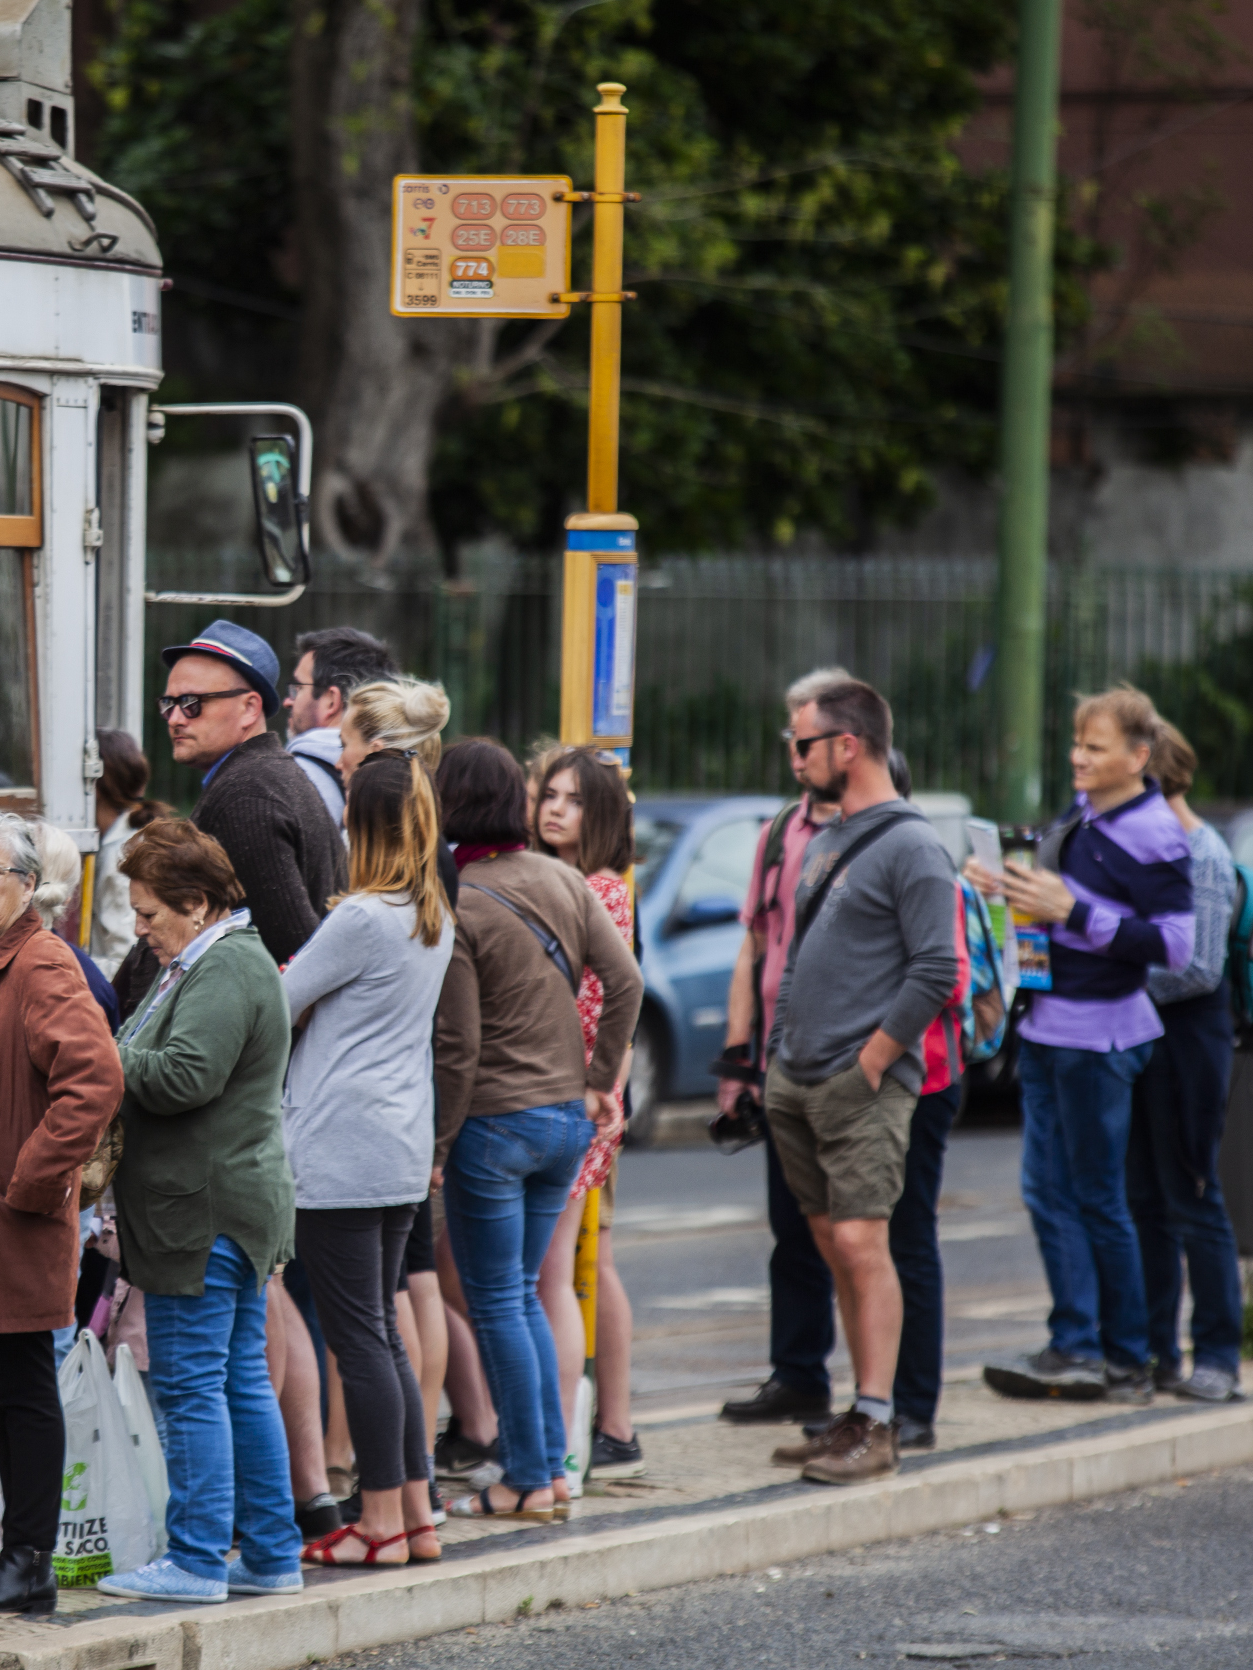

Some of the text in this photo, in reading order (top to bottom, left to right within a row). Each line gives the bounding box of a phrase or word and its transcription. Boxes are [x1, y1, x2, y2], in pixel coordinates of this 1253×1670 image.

[458, 199, 540, 215] 713 773
[457, 230, 541, 246] 25E 28E
[455, 262, 489, 277] 774
[406, 295, 438, 306] 3599
